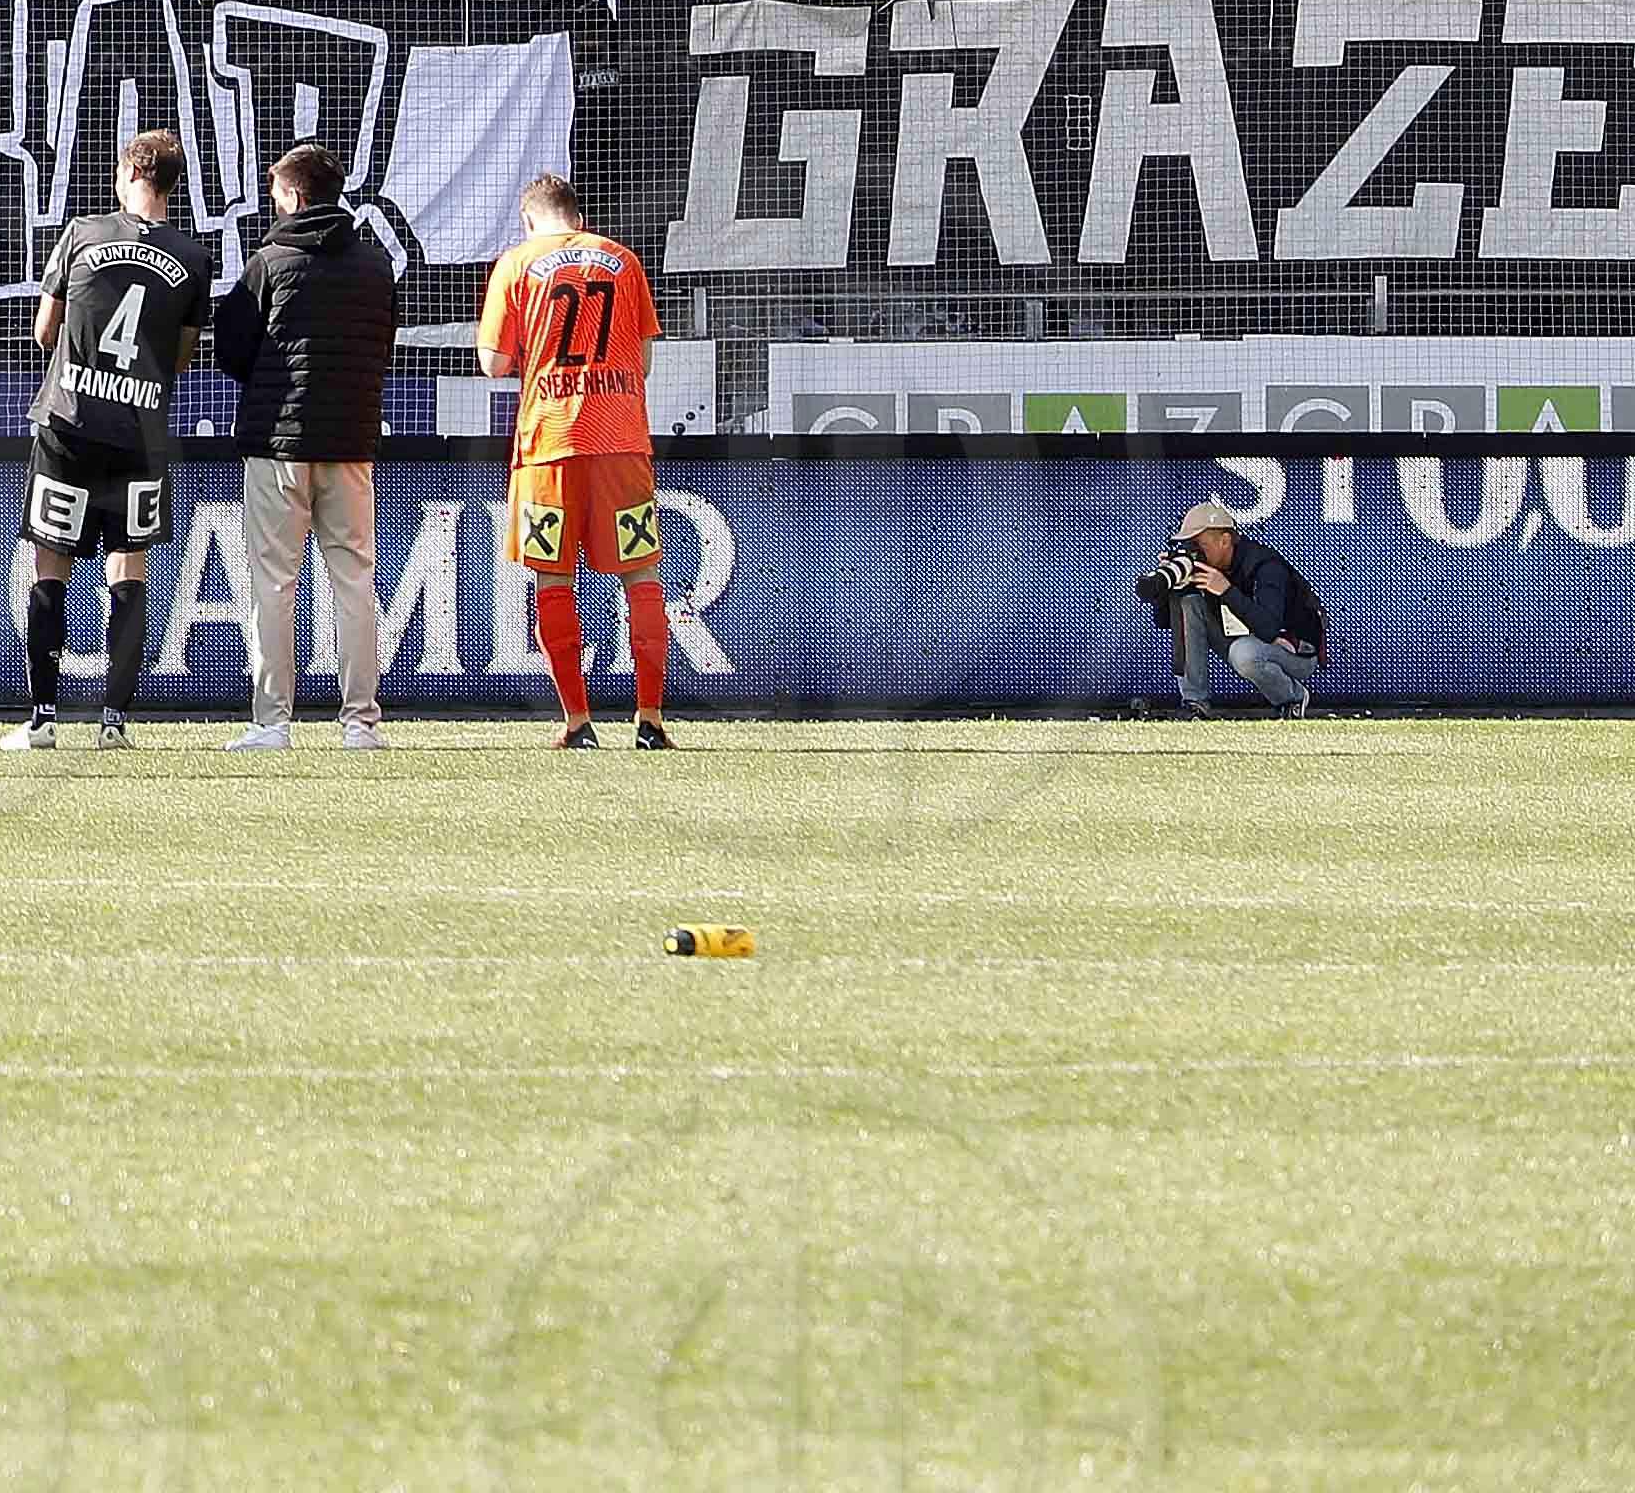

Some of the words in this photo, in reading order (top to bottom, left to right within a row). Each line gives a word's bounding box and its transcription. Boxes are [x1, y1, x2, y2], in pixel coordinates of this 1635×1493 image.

[86, 243, 189, 288] PUNTIGAMER
[98, 283, 146, 372] 4
[549, 281, 616, 365] 27
[59, 363, 164, 412] STANKOVIC
